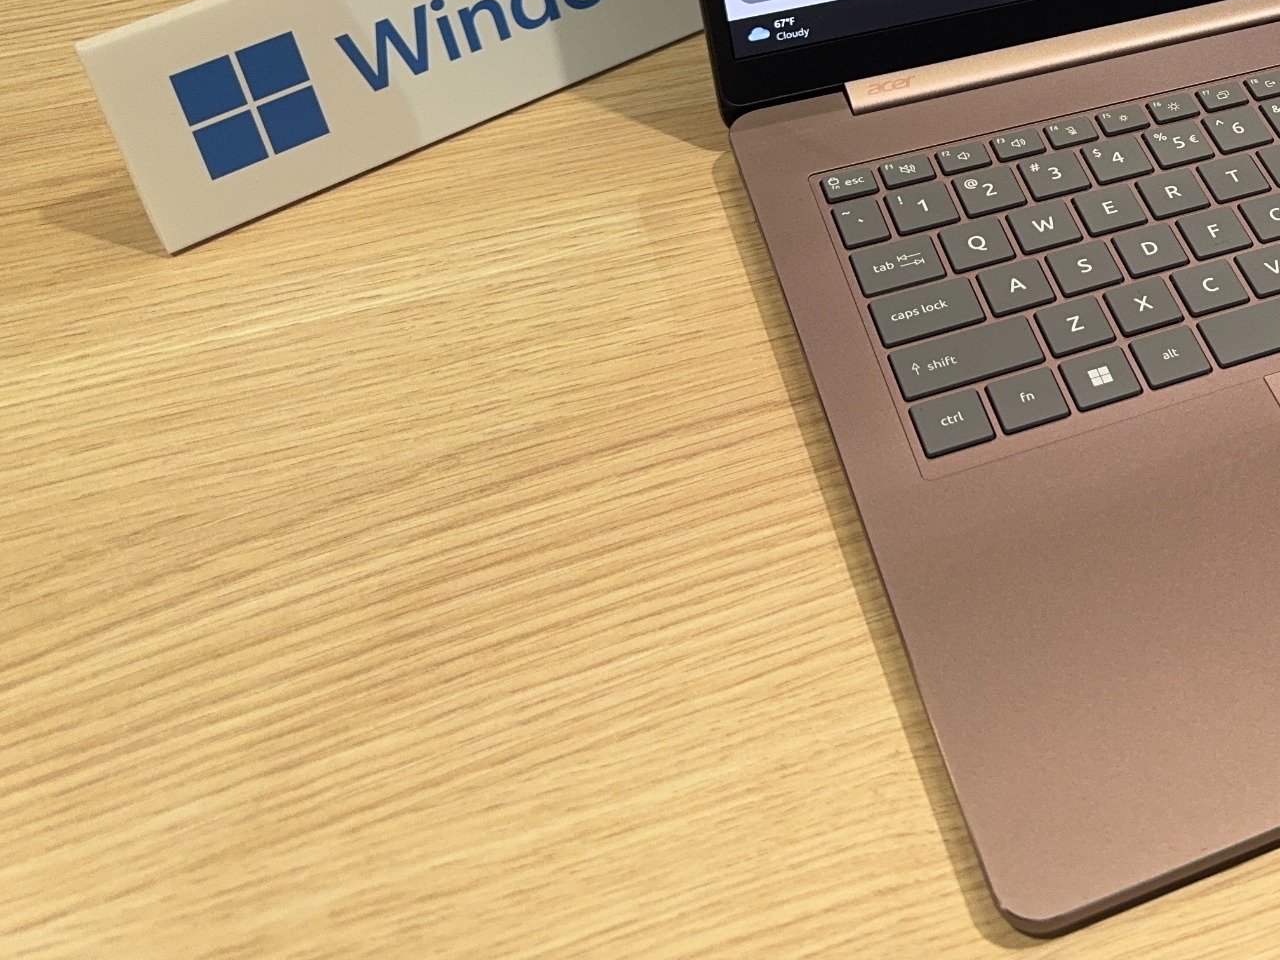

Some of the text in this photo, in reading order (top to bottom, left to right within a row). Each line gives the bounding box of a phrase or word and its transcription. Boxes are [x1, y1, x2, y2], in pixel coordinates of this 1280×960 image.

[773, 16, 796, 30] 67°F
[775, 26, 810, 42] Cloudy
[867, 74, 916, 97] acer
[845, 175, 865, 187] esc
[1101, 200, 1118, 215] E
[1031, 216, 1055, 233] W
[967, 235, 988, 252] Q
[873, 259, 895, 274] tab
[890, 298, 949, 323] caps lock
[1161, 347, 1180, 361] alt
[926, 354, 958, 372] shift
[1019, 390, 1036, 403] fn
[940, 411, 965, 428] ctrl
